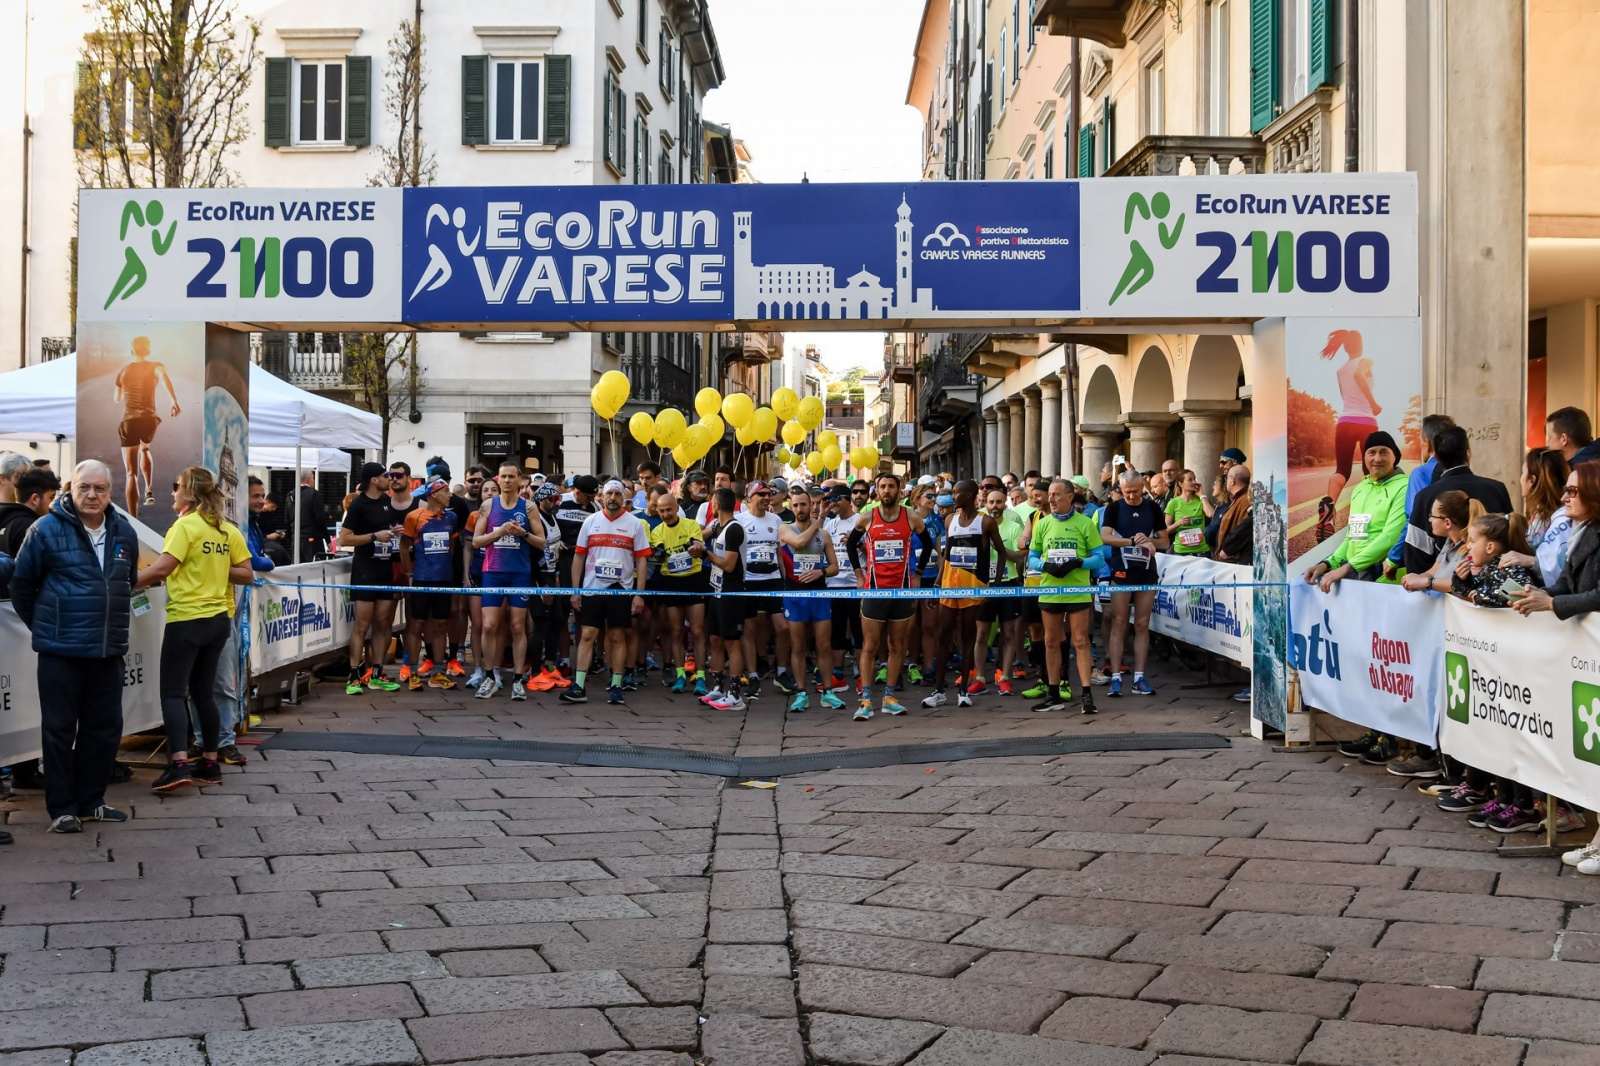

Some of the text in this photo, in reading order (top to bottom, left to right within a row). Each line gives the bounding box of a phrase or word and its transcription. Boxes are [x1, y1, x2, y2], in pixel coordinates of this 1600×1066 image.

[187, 200, 376, 221] EcoRun VARESE
[1196, 193, 1391, 215] EcoRun VARESE
[485, 199, 719, 250] EcoRun
[975, 226, 1029, 235] Associazione
[975, 236, 1069, 247] Sportiva Dilettantistica
[920, 250, 1046, 260] CAMPUS VARESE RUNNERS
[472, 253, 726, 305] VARESE
[756, 552, 771, 560] 238
[884, 548, 896, 557] 29
[960, 555, 965, 563] 1
[601, 566, 616, 576] 140
[798, 562, 816, 570] 307
[265, 616, 298, 645] VARESE
[1372, 631, 1411, 667] Rigoni
[135, 652, 143, 666] DI
[1571, 655, 1596, 673] Con il
[1, 674, 11, 690] DI
[1369, 662, 1414, 703] di Asiago
[1472, 669, 1532, 705] Regione
[1472, 702, 1554, 740] Lombardia
